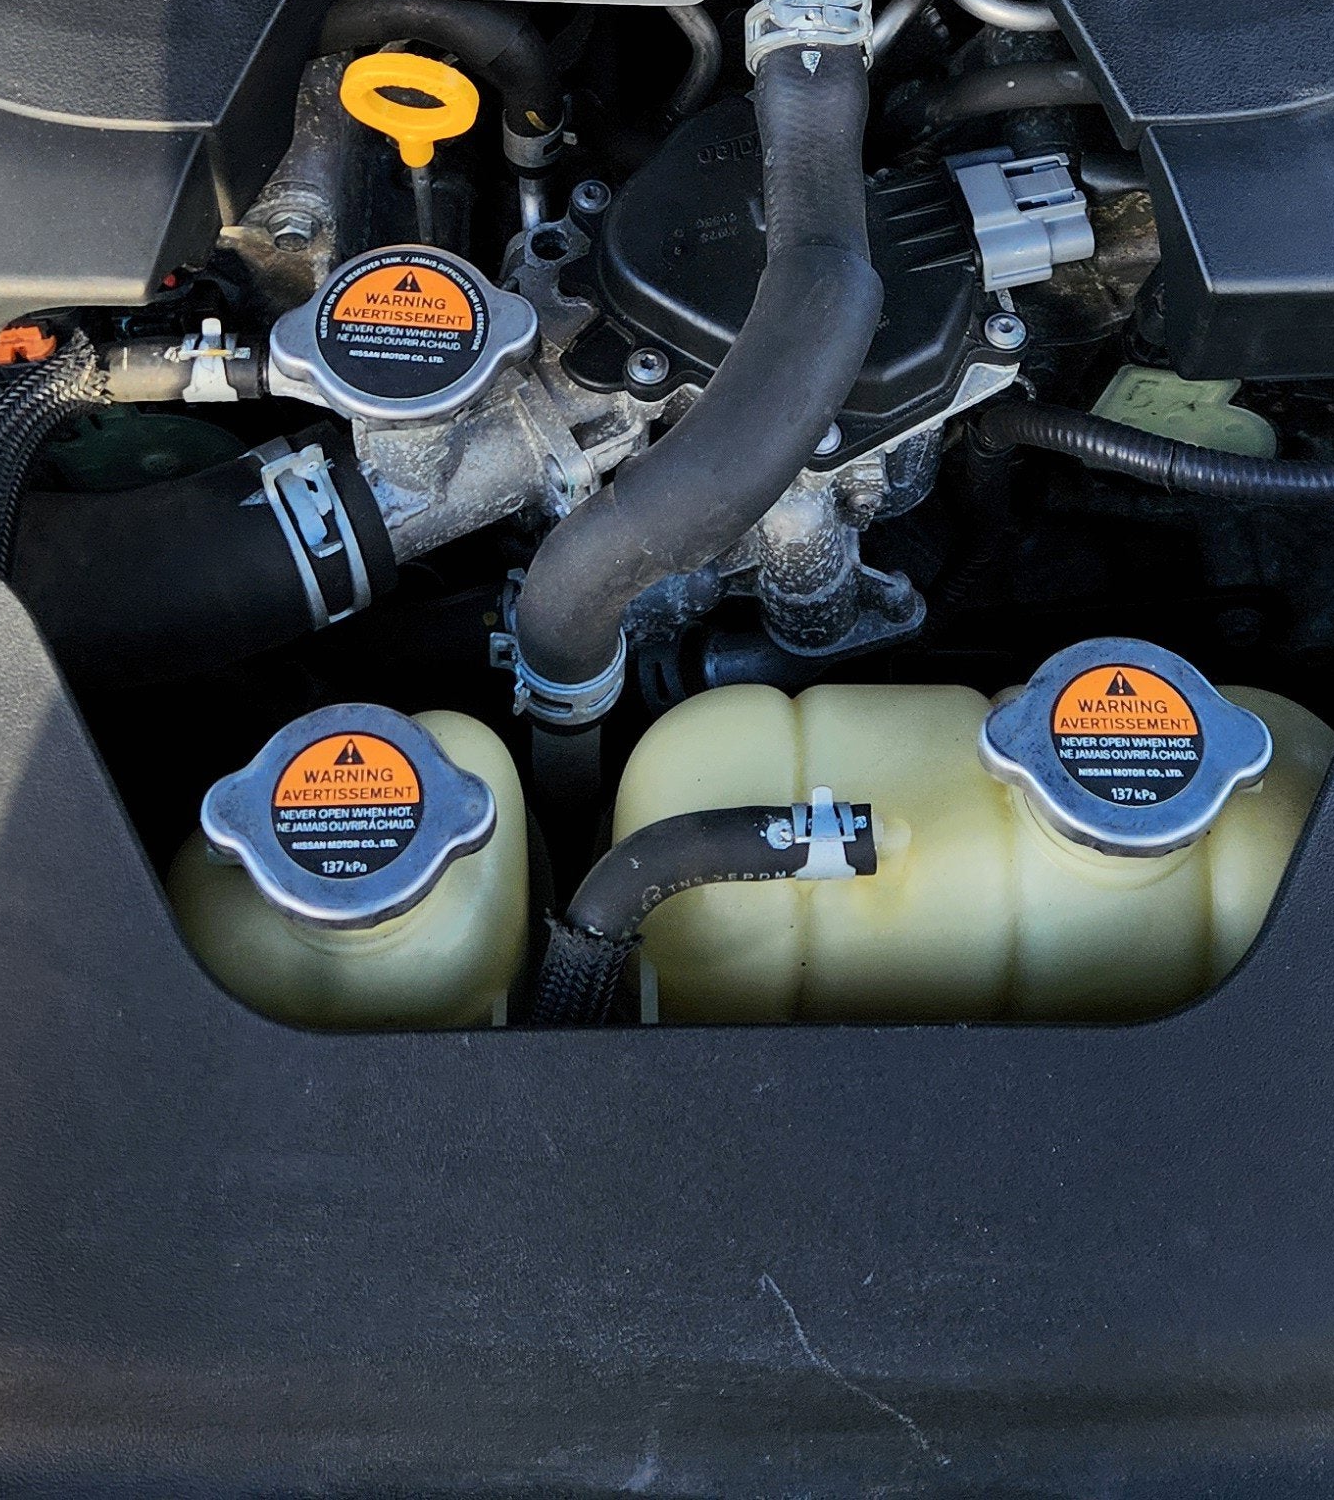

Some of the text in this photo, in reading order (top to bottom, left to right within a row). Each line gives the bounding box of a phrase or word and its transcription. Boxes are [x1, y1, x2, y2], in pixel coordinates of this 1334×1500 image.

[410, 256, 438, 268] JAMAIS
[365, 292, 447, 310] WARNING
[342, 308, 466, 327] AVERTISSEMENT
[340, 323, 374, 333] NEVER
[375, 325, 403, 336] OPEN
[405, 327, 437, 338] WHEN
[336, 332, 349, 342] NE
[350, 333, 384, 345] JAMAIS
[383, 336, 419, 348] OUVRIR
[348, 349, 380, 358] NISSAN
[380, 351, 411, 361] MOTOR
[428, 355, 445, 364] LTD.
[1077, 698, 1168, 715] WARNING
[1059, 716, 1191, 731] AVERTISSEMENT
[1061, 737, 1194, 748] NEVER OPEN WHEN HOT.
[1059, 749, 1074, 759] NE
[1074, 749, 1111, 760] JAMAIS
[1111, 749, 1150, 760] OUVRIR
[1158, 750, 1199, 761] CHAUD.
[304, 767, 393, 784] WARNING
[1078, 767, 1112, 777] NISSAN
[1112, 768, 1146, 778] MOTOR
[1164, 769, 1184, 778] LTD.
[282, 785, 414, 802] AVERTISSEMENT
[1110, 787, 1157, 801] 137 kPa
[280, 806, 414, 821] NEVER OPEN WHEN HOT.
[276, 822, 291, 833] NE
[291, 821, 328, 833] JAMAIS
[328, 820, 369, 832] OUVRIR
[376, 819, 416, 831] CHAUD.
[292, 840, 327, 850] NISSAN
[327, 839, 360, 849] MOTOR
[379, 838, 399, 848] LTD.
[321, 860, 368, 874] 137 kPa
